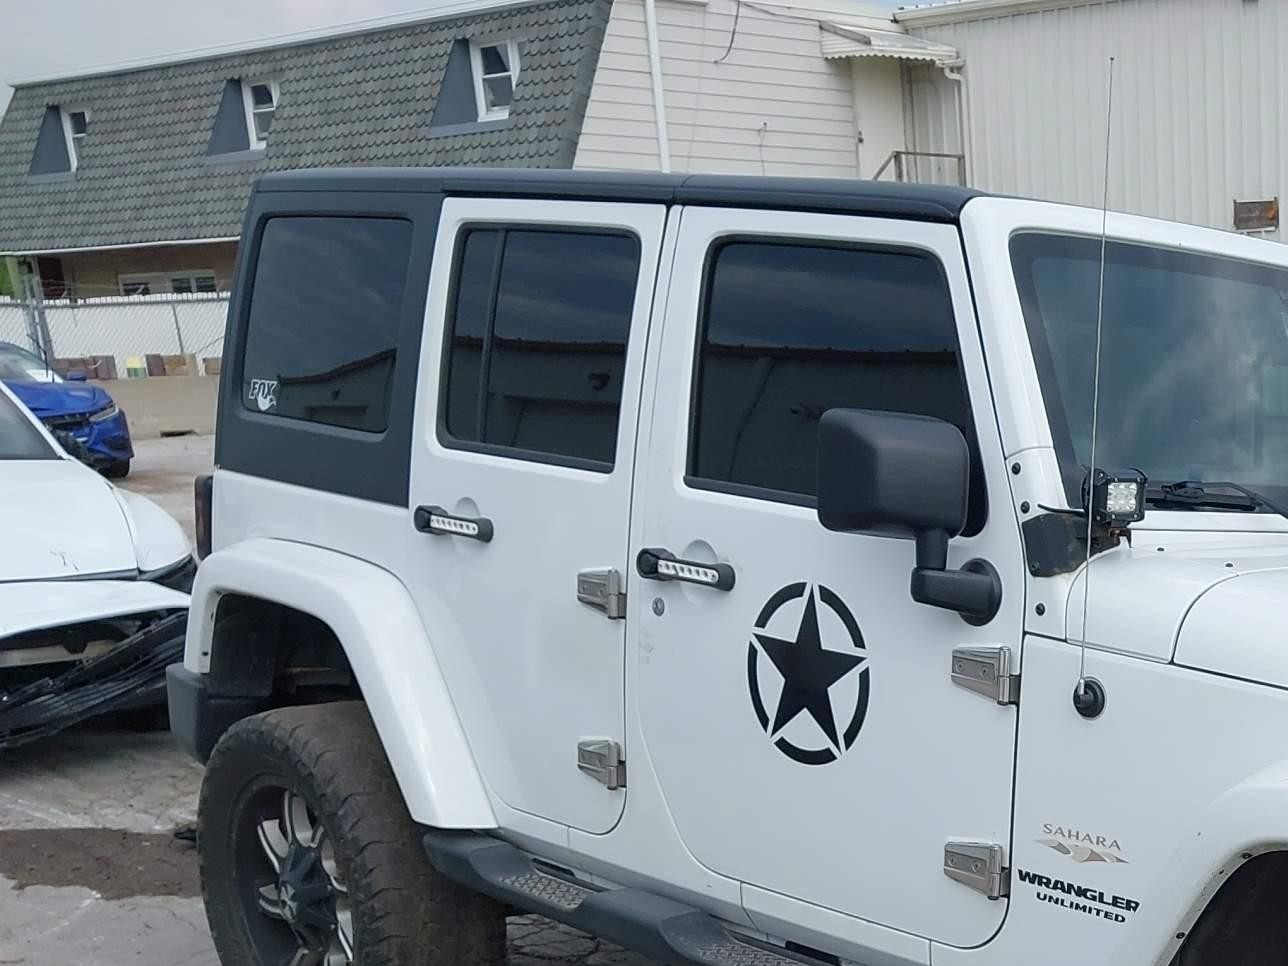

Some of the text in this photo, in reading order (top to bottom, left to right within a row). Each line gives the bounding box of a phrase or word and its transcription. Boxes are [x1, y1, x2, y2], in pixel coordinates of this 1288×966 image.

[248, 379, 277, 402] FOX
[1042, 823, 1122, 851] SAHARA
[1017, 868, 1140, 913] WRANGLER
[1036, 891, 1126, 923] UNLIMITED
